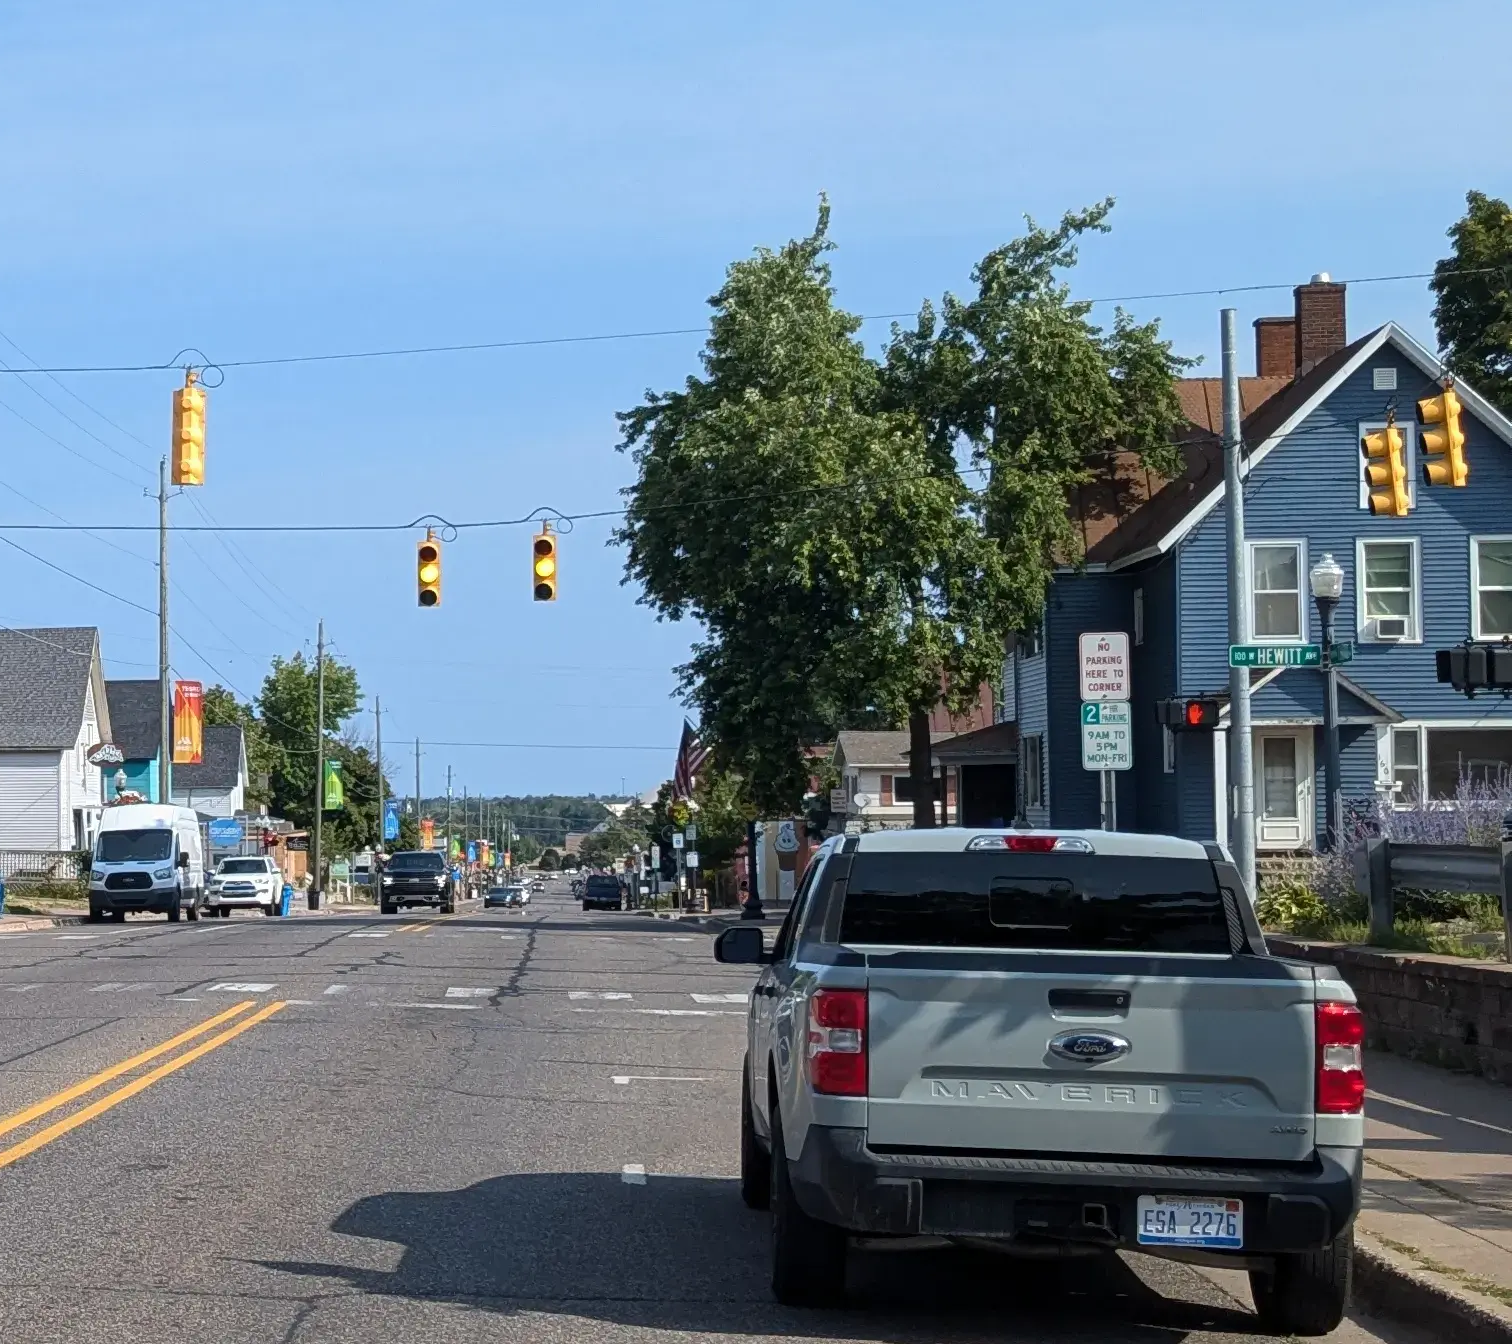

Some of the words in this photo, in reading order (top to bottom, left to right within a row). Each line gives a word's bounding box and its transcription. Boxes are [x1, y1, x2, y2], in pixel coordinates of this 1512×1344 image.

[1097, 642, 1110, 652] NO
[1085, 656, 1123, 665] PARKING
[1257, 648, 1303, 665] HEWITT
[1085, 669, 1108, 679] HERE
[1113, 668, 1124, 678] TO
[1088, 682, 1122, 692] CORNER
[1086, 705, 1097, 722] 2
[1113, 730, 1126, 740] TO
[1086, 753, 1128, 763] MON-FRI
[1073, 1038, 1107, 1053] Ford
[930, 1080, 1249, 1109] MAVERICK
[1143, 1209, 1177, 1234] ESA
[1189, 1211, 1237, 1237] 2276
